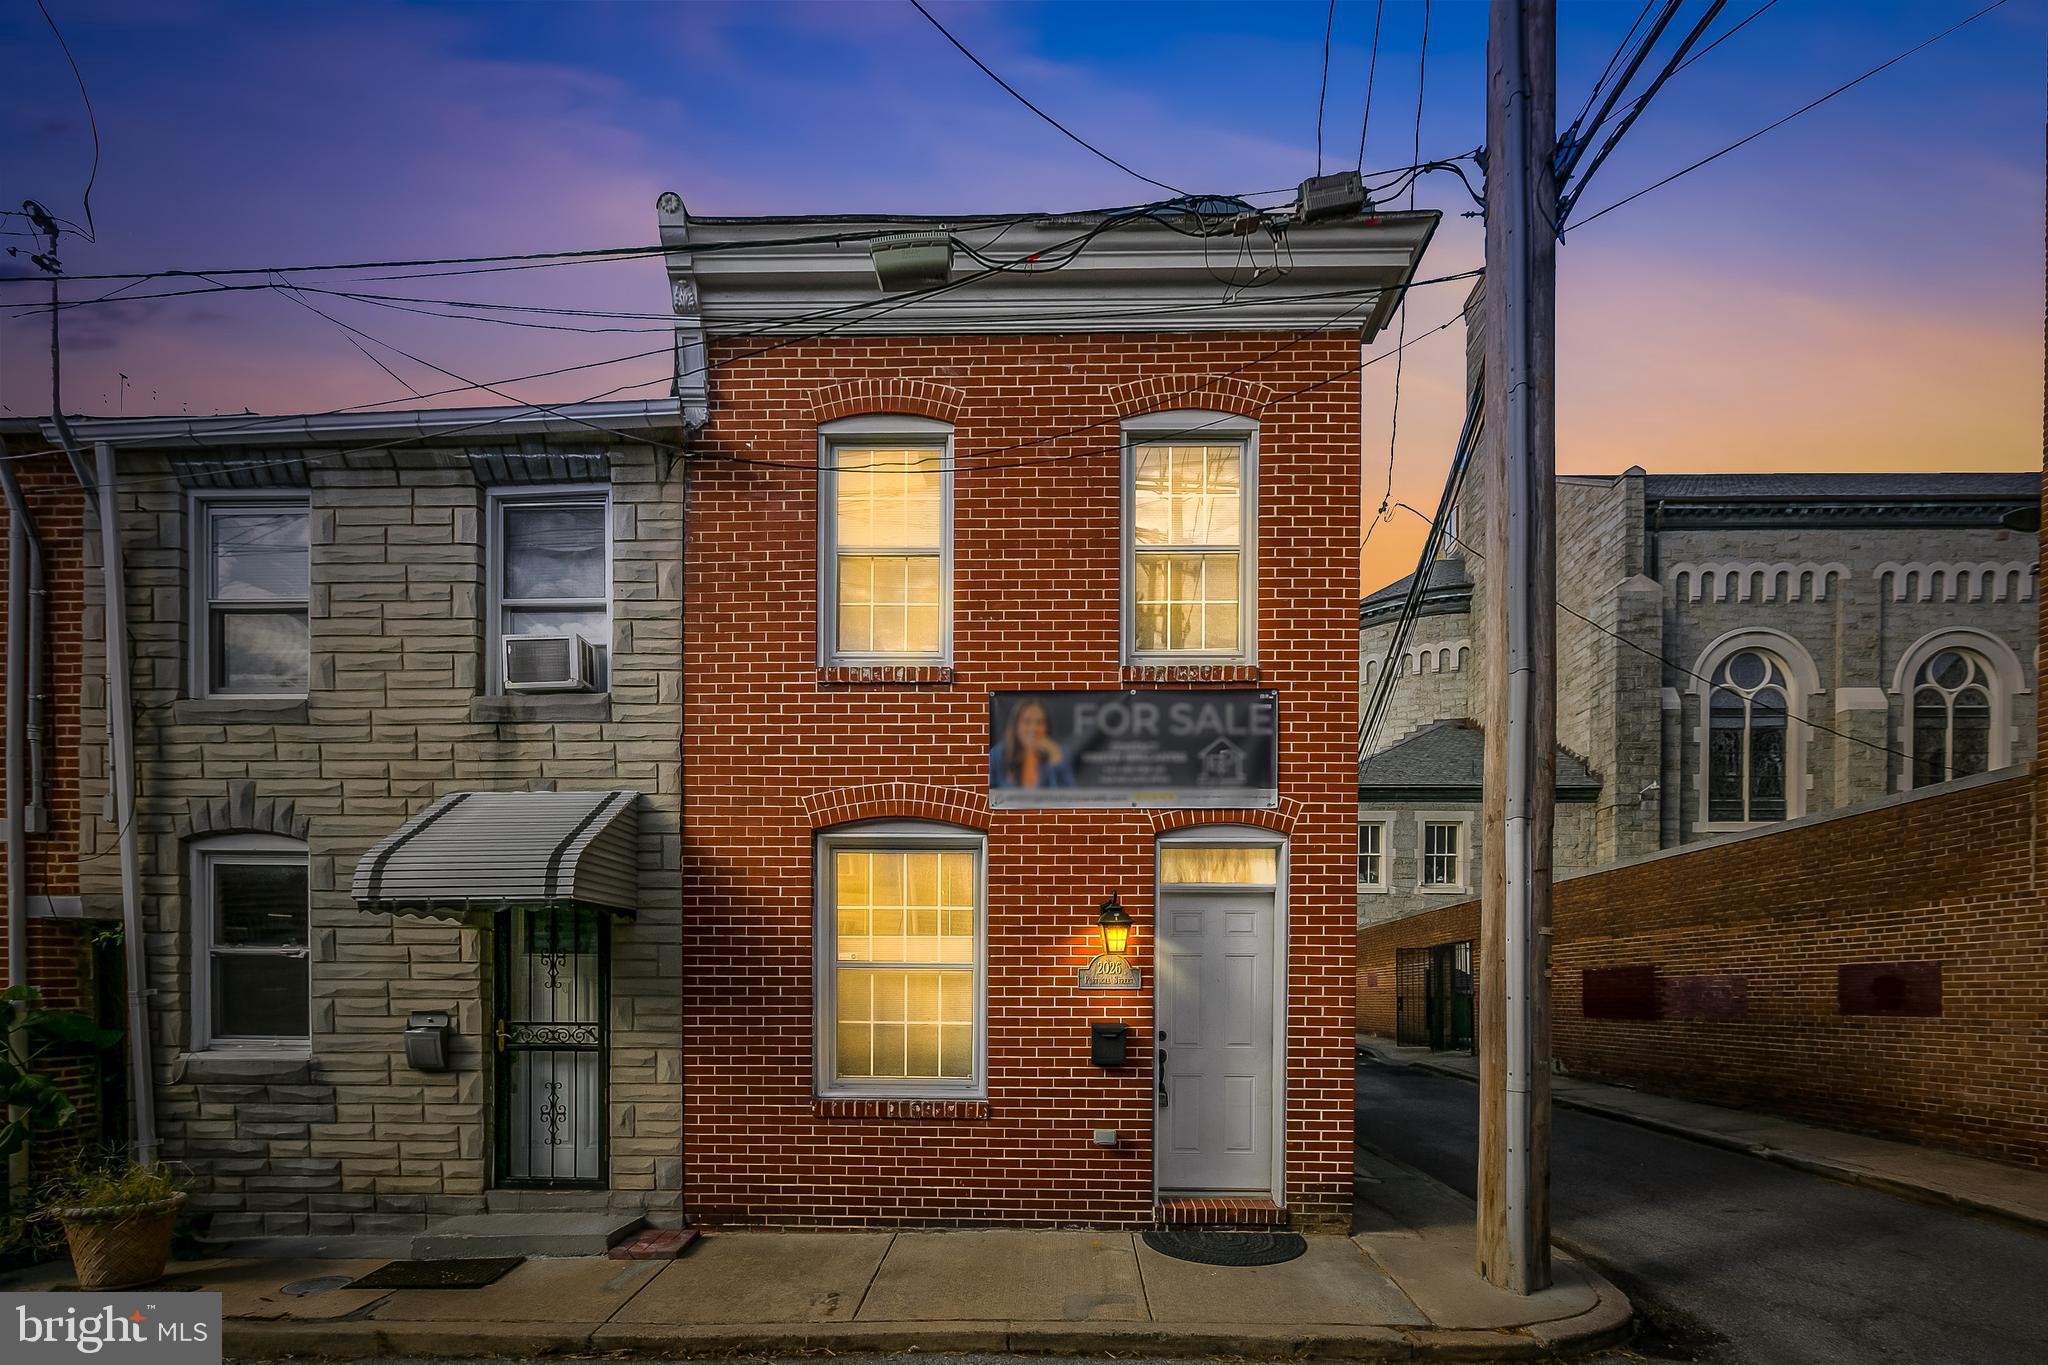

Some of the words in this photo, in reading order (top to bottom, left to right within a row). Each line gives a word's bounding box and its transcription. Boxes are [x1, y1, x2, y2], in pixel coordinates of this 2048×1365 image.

[1073, 703, 1160, 736] FOR
[1169, 702, 1273, 736] SALE
[1097, 961, 1122, 974] 2026
